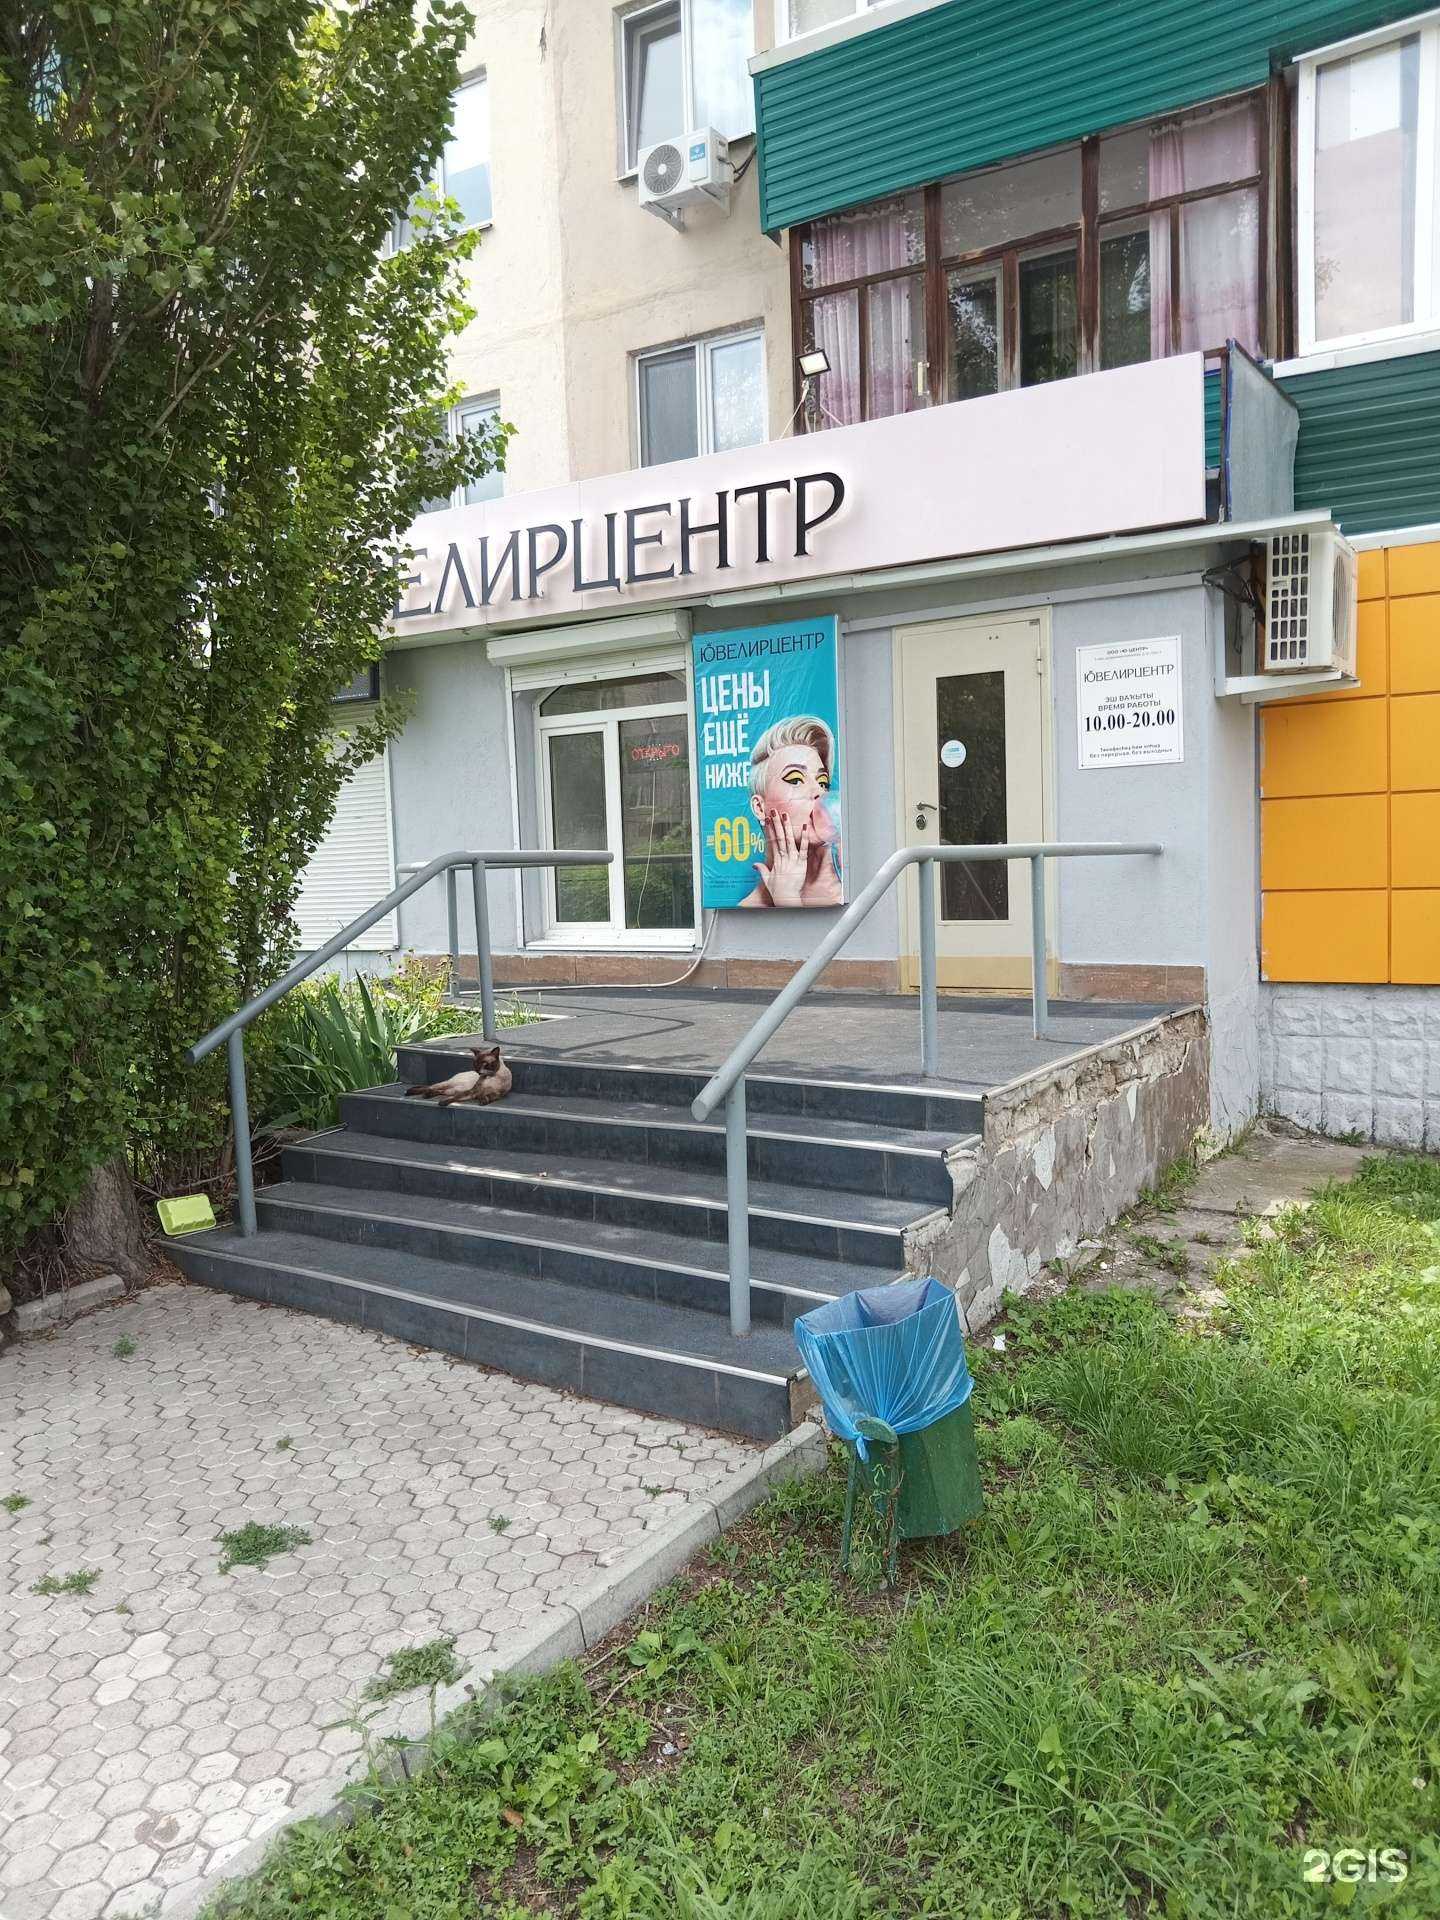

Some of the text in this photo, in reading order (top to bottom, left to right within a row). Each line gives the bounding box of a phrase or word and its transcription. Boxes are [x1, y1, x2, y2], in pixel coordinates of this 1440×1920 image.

[700, 632, 825, 663] ЮВЕЛИРЦЕНТР
[1084, 664, 1175, 683] ЮВЕЛИРЦЕНТР
[701, 669, 770, 716] ЦЕНЫ
[1097, 700, 1161, 711] ВРЕМЯ РАБОТЫ
[1085, 709, 1175, 732] 10.00-20.00
[703, 712, 750, 757] ЕЩЁ
